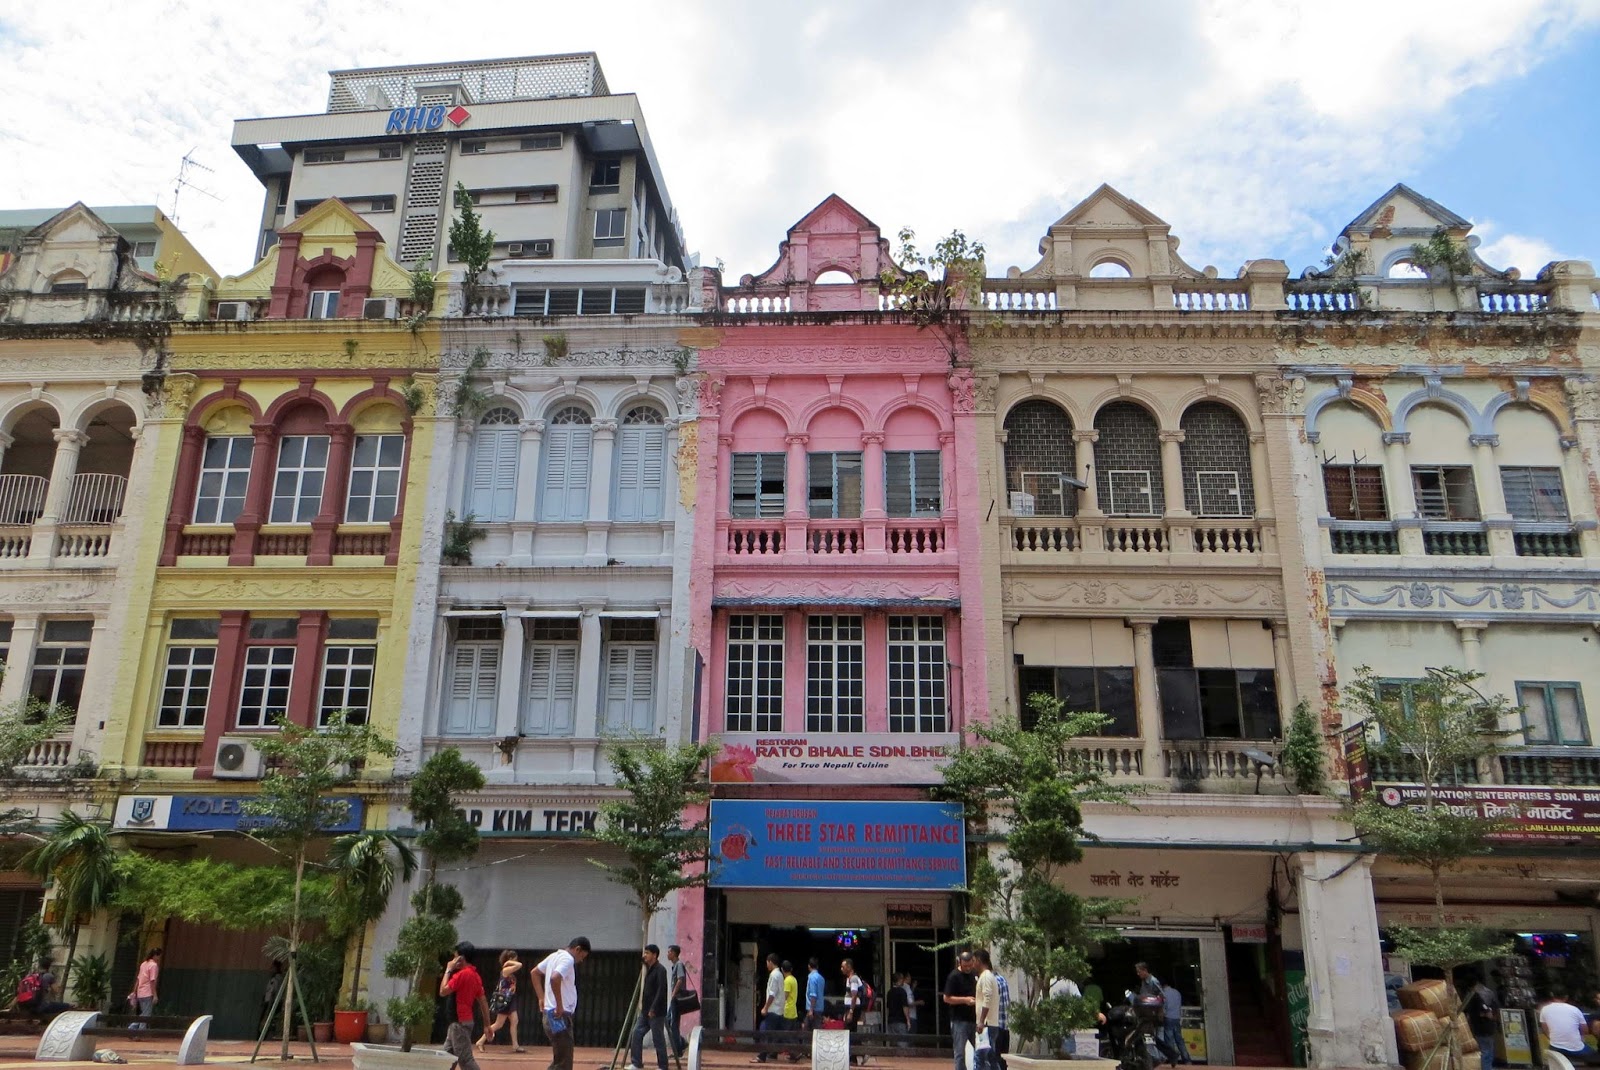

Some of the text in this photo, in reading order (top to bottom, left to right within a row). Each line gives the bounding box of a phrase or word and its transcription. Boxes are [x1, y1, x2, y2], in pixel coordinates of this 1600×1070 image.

[386, 105, 447, 133] RHB
[756, 746, 803, 758] RATO
[808, 746, 864, 758] BHALE
[823, 761, 854, 770] Nepali
[1402, 789, 1600, 801] NEW NATION ENTERPRISES SDN. BH
[238, 819, 266, 828] SINCE
[493, 810, 532, 831] KIM
[544, 810, 598, 832] TECK
[767, 823, 960, 844] THREE STAR REMITTANCE
[786, 856, 820, 869] RELIABLE
[823, 856, 840, 869] AND
[842, 857, 876, 870] SECURED
[878, 857, 926, 871] REMITTANCE
[928, 858, 959, 872] SERVICE
